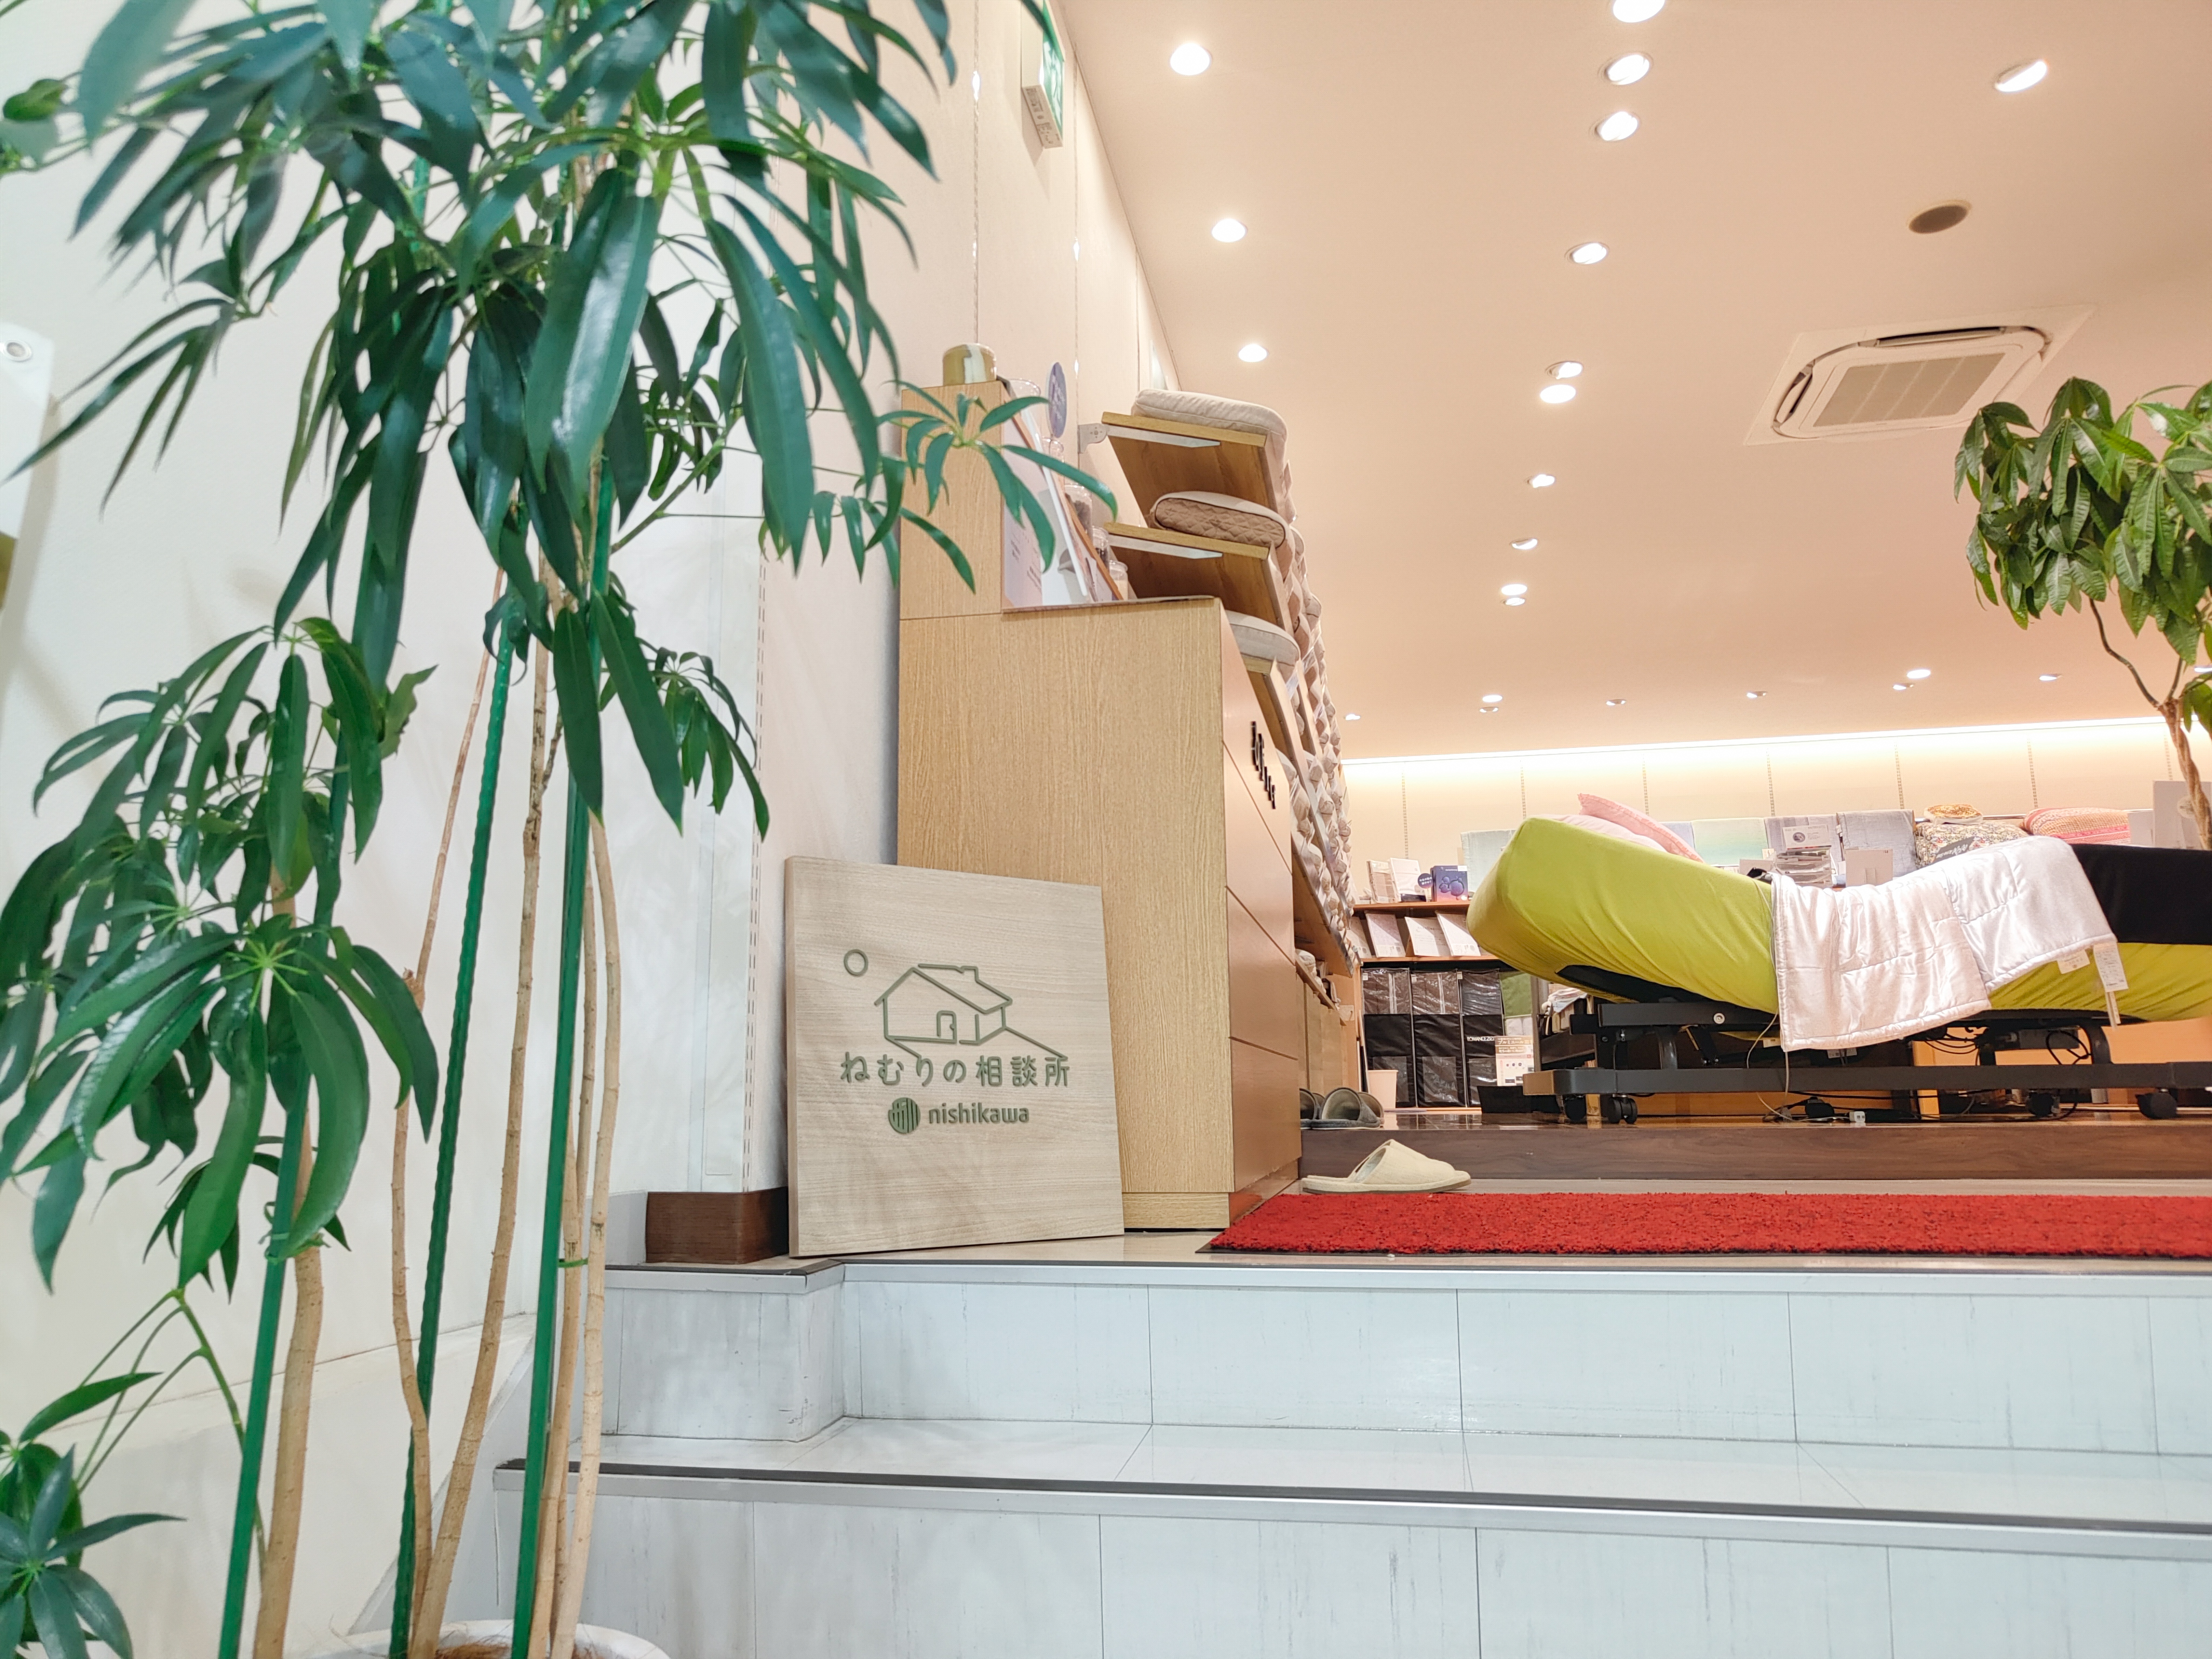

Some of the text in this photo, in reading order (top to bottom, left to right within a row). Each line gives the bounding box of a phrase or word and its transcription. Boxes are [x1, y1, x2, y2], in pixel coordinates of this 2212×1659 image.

[841, 1051, 1070, 1087] ねむりの相談所
[928, 1102, 1030, 1124] nishikawa
